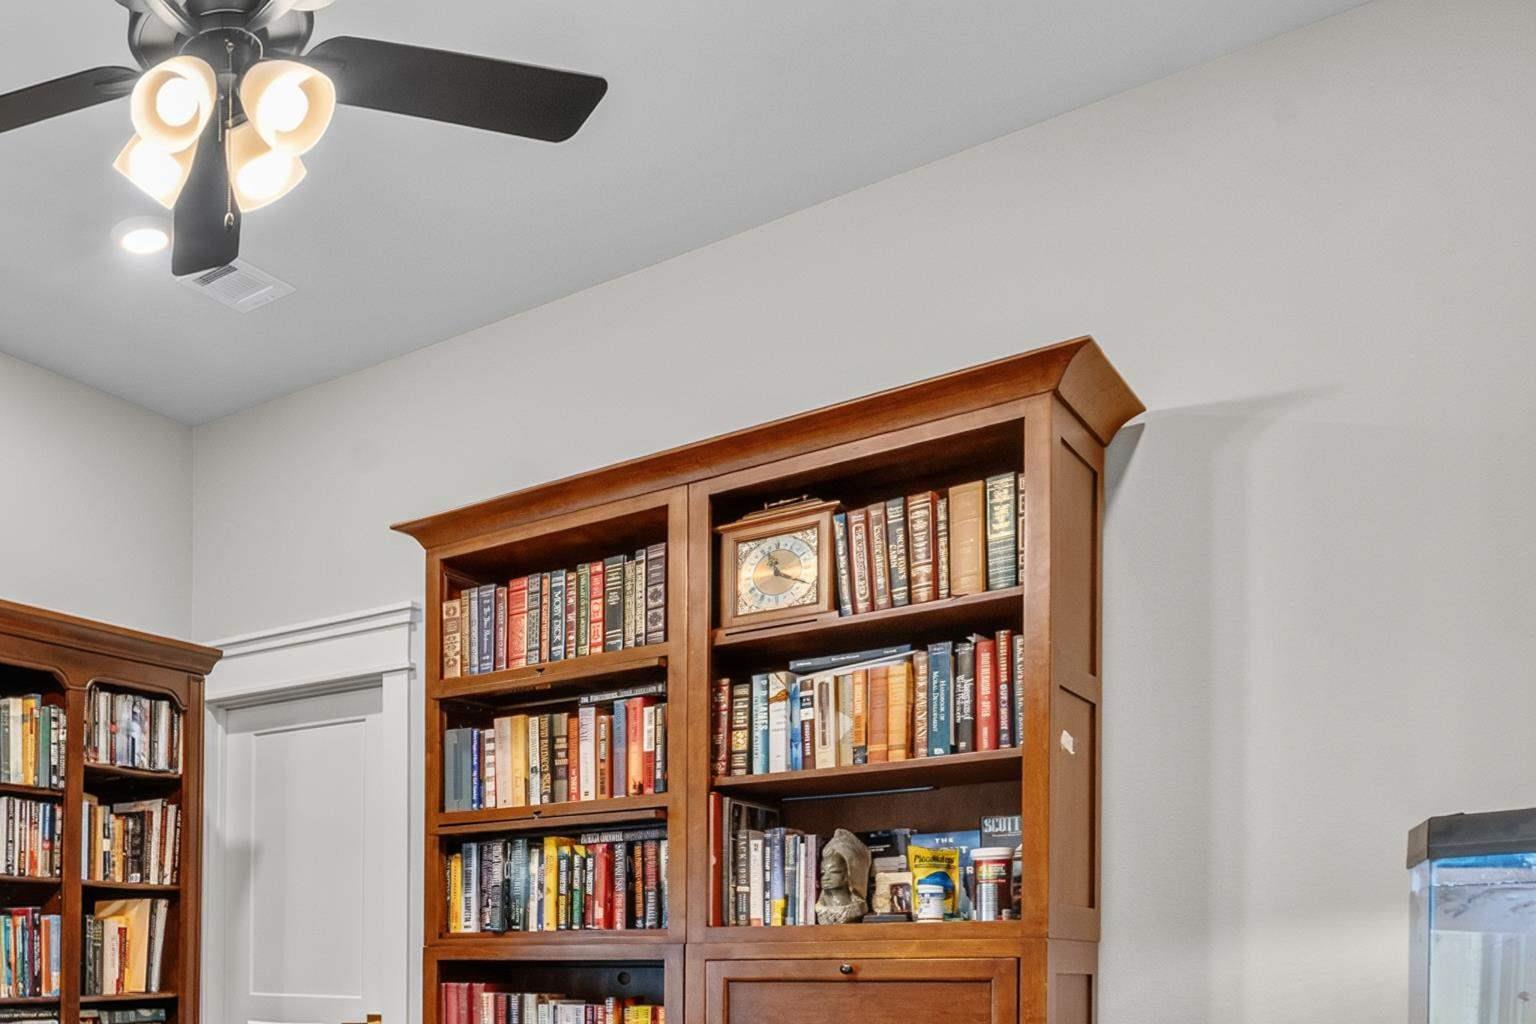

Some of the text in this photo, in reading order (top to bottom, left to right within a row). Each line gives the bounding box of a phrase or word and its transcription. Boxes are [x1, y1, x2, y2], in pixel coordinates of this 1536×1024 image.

[896, 527, 905, 554] UNCLE
[553, 590, 562, 644] MOBY DICK
[758, 703, 768, 731] JAMES
[541, 739, 550, 771] BALDACCI
[983, 816, 1020, 833] SCOTT
[615, 844, 624, 861] SARA
[738, 834, 748, 860] JACK
[559, 859, 567, 871] SARA
[615, 861, 625, 893] PARETSKY
[464, 846, 472, 923] PATRICIA CORNWELL SCARPETTA
[559, 872, 567, 895] PARETSKY
[585, 872, 593, 896] PARETSKY
